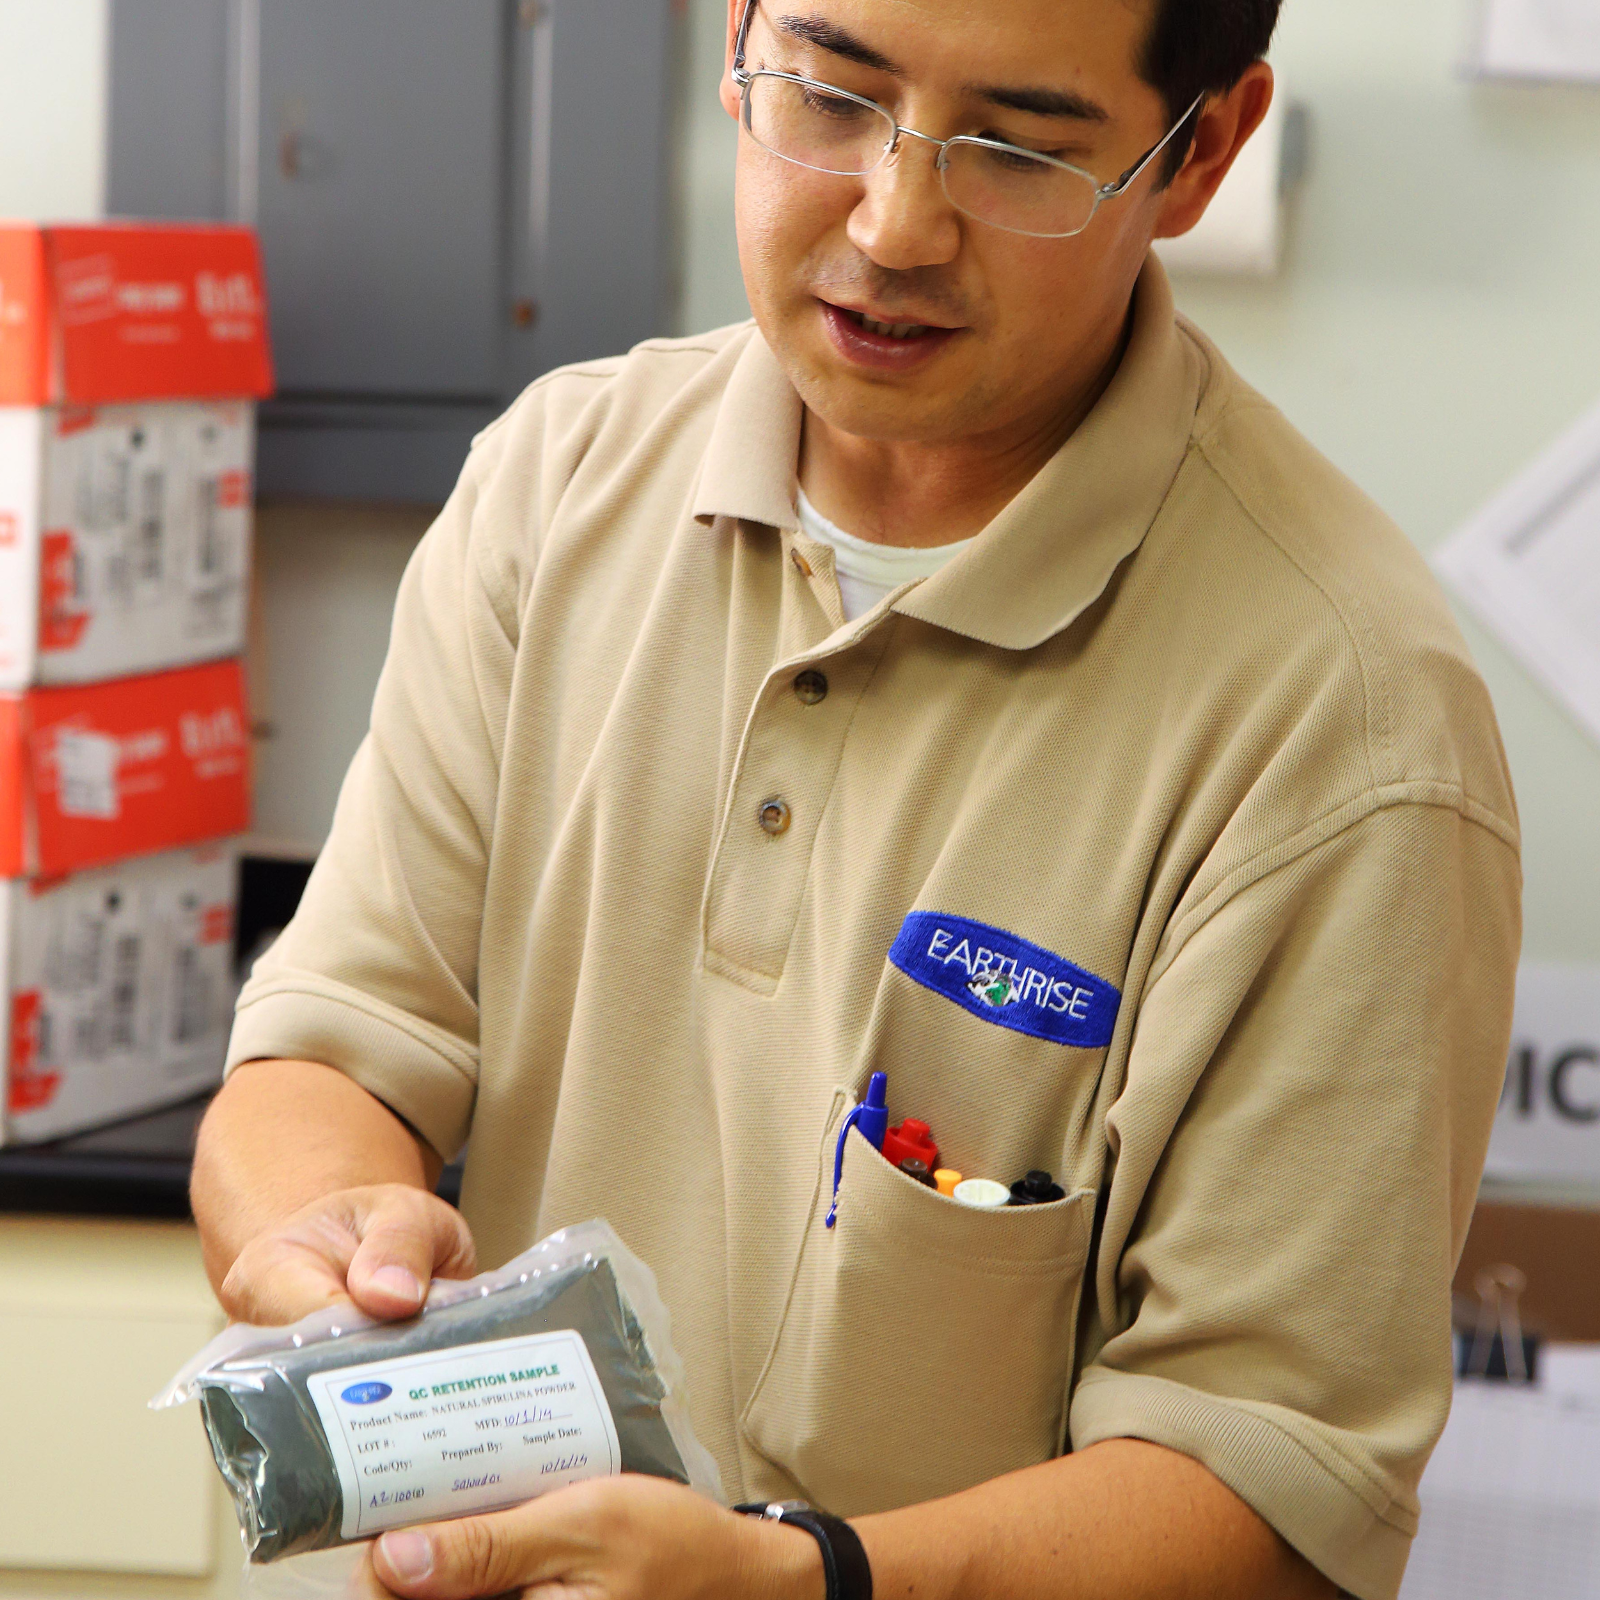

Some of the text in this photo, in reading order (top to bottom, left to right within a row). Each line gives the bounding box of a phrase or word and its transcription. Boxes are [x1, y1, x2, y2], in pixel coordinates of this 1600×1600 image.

[927, 928, 1094, 1020] EARTHRISE
[350, 1380, 576, 1432] Product Name: NATURAL SPIRULINA POWDER
[409, 1363, 560, 1401] QC RETENTION SAMPLE
[357, 1440, 380, 1455] LOT
[474, 1416, 502, 1432] MFD:
[363, 1426, 582, 1477] Code/Qty: Prepared By: Sample Date:
